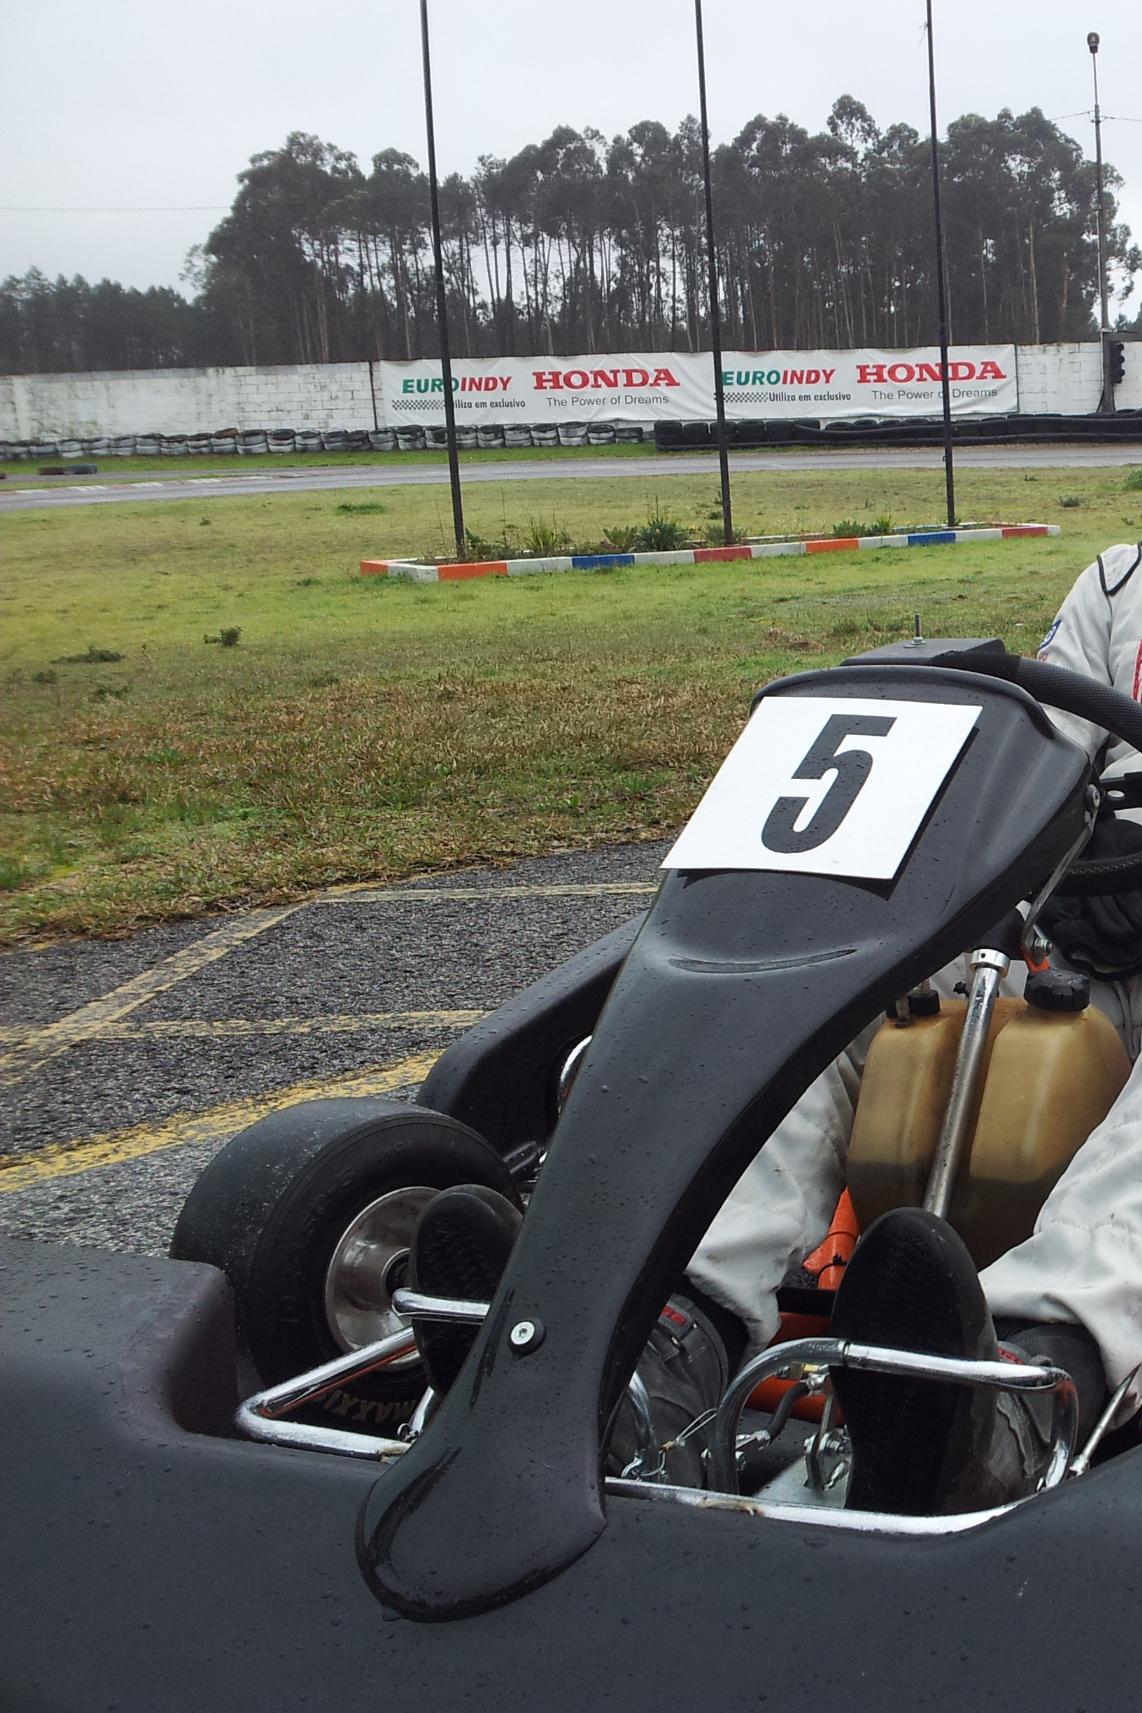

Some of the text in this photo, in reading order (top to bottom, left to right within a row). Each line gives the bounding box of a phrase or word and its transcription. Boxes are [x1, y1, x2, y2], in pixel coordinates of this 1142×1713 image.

[532, 368, 680, 390] HONDA
[722, 369, 836, 386] EUROINDY
[856, 361, 1007, 384] HONDA
[546, 394, 669, 407] The Power of Dreams
[769, 390, 851, 402] Utiliza em exclusivo
[872, 390, 894, 400] The
[898, 389, 934, 400] Power
[952, 388, 998, 398] Dreams
[475, 400, 487, 408] em
[490, 397, 526, 408] exclusivo
[761, 713, 898, 854] 5
